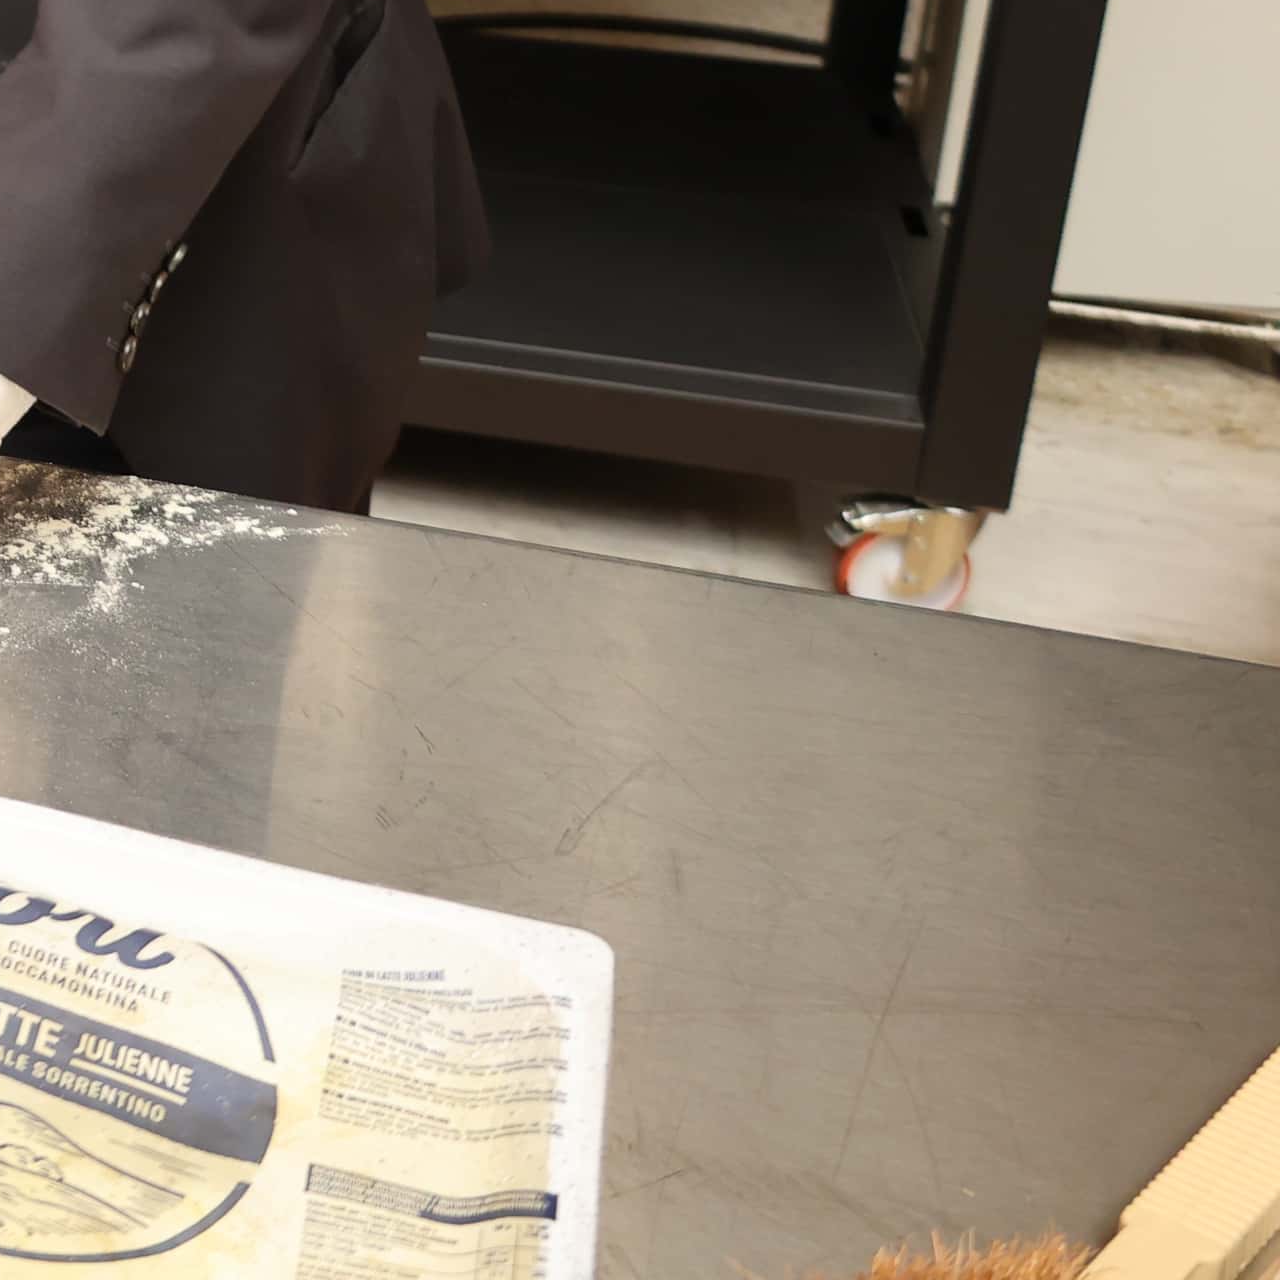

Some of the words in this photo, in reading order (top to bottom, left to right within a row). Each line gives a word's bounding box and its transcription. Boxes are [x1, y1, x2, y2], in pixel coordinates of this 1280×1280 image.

[7, 938, 70, 971] CUORE
[75, 961, 174, 1005] NATURALE
[32, 1061, 168, 1123] SORRENTINO
[71, 1032, 194, 1095] JULIENNE
